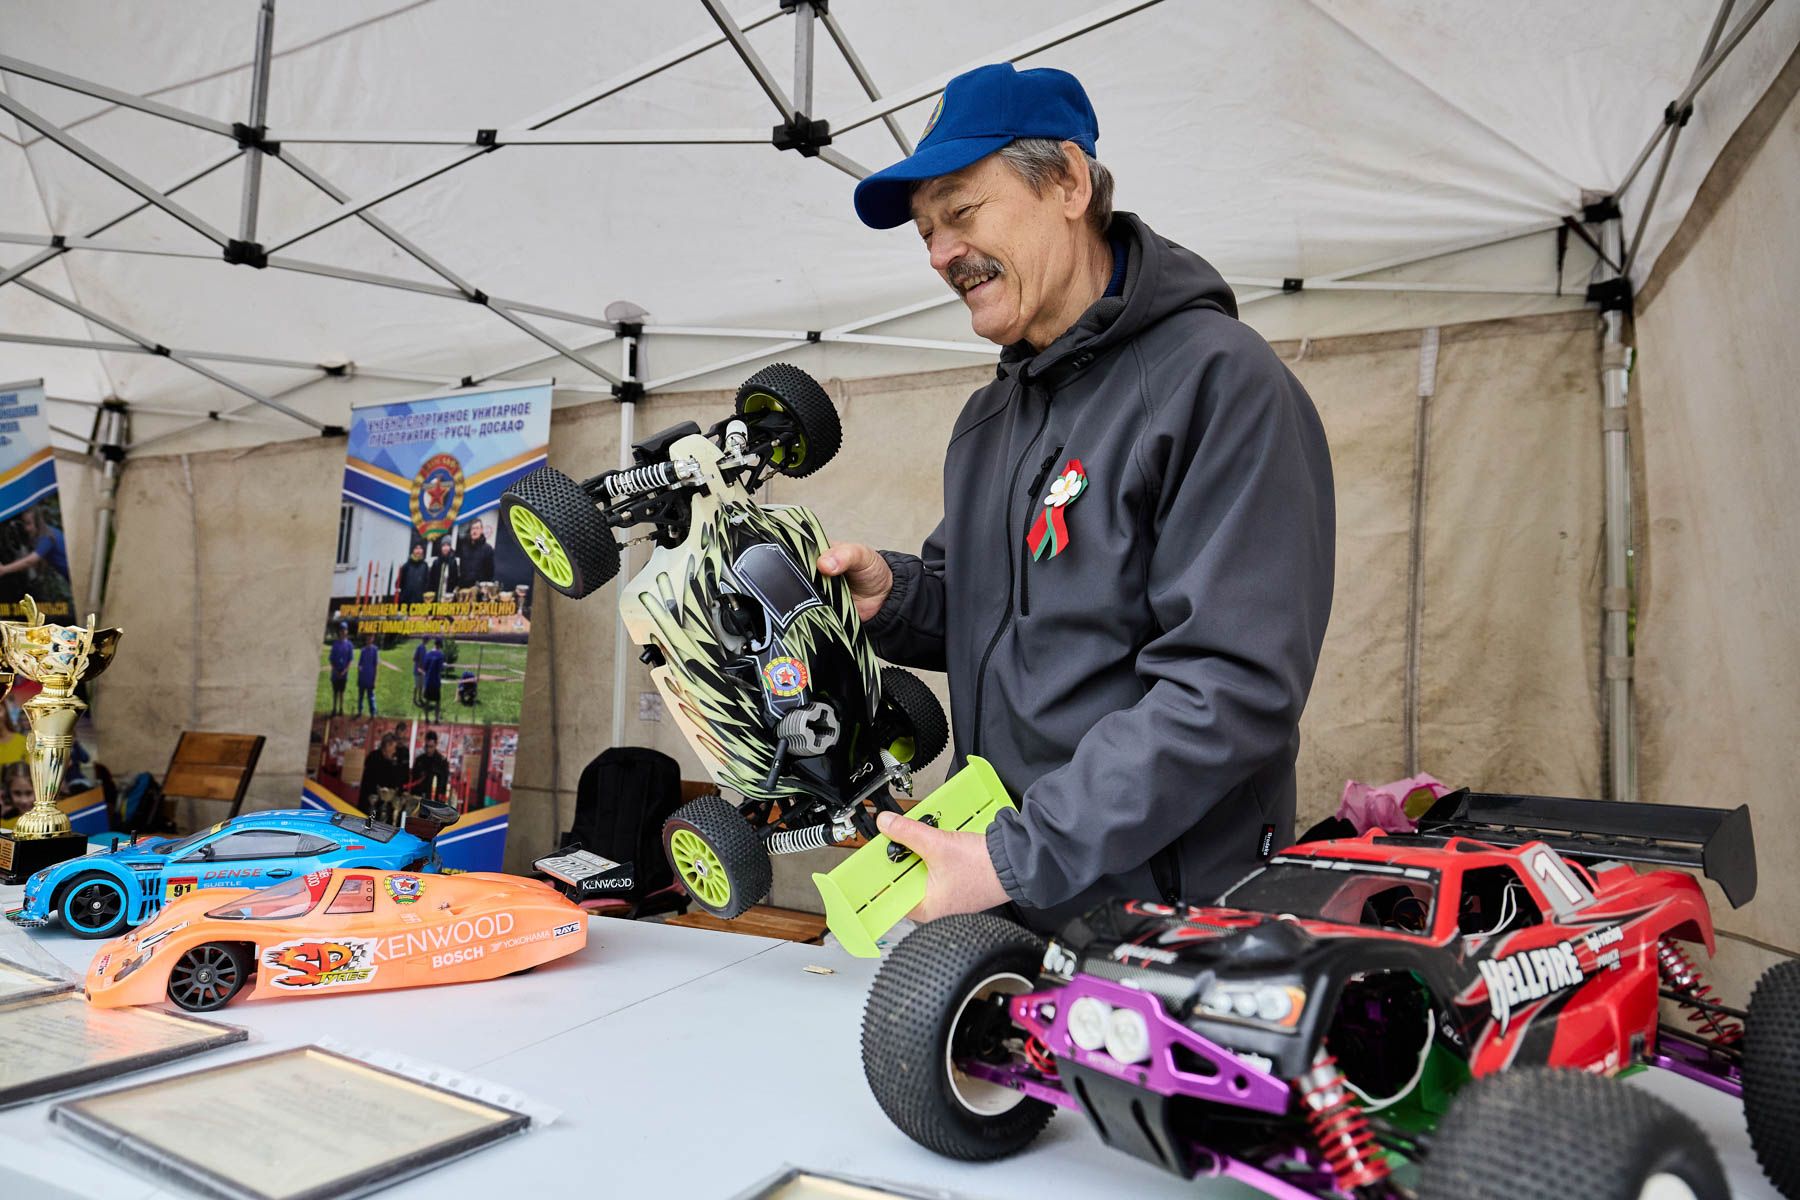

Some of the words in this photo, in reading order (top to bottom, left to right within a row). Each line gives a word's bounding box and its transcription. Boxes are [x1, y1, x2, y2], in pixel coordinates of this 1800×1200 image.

[472, 402, 531, 421] УНИТАРНОЕ
[368, 428, 437, 447] ПРЕДПРИЯТИЕ
[479, 419, 525, 437] ДОСААФ
[409, 602, 469, 616] СПОРТИВНУЮ
[472, 602, 516, 616] СЕКЦИЮ
[358, 620, 449, 635] РАКЕТОМОДЕЛЬНОГО
[204, 868, 263, 880] DENSE
[1532, 850, 1584, 906] 1
[174, 884, 192, 897] 91
[582, 878, 633, 890] KENWOOD
[371, 912, 514, 963] KENWOOD
[555, 923, 579, 936] RAYS
[503, 930, 550, 948] YOKOHAMA
[433, 947, 483, 968] BOSCH
[1478, 941, 1584, 1036] HELLFIRE
